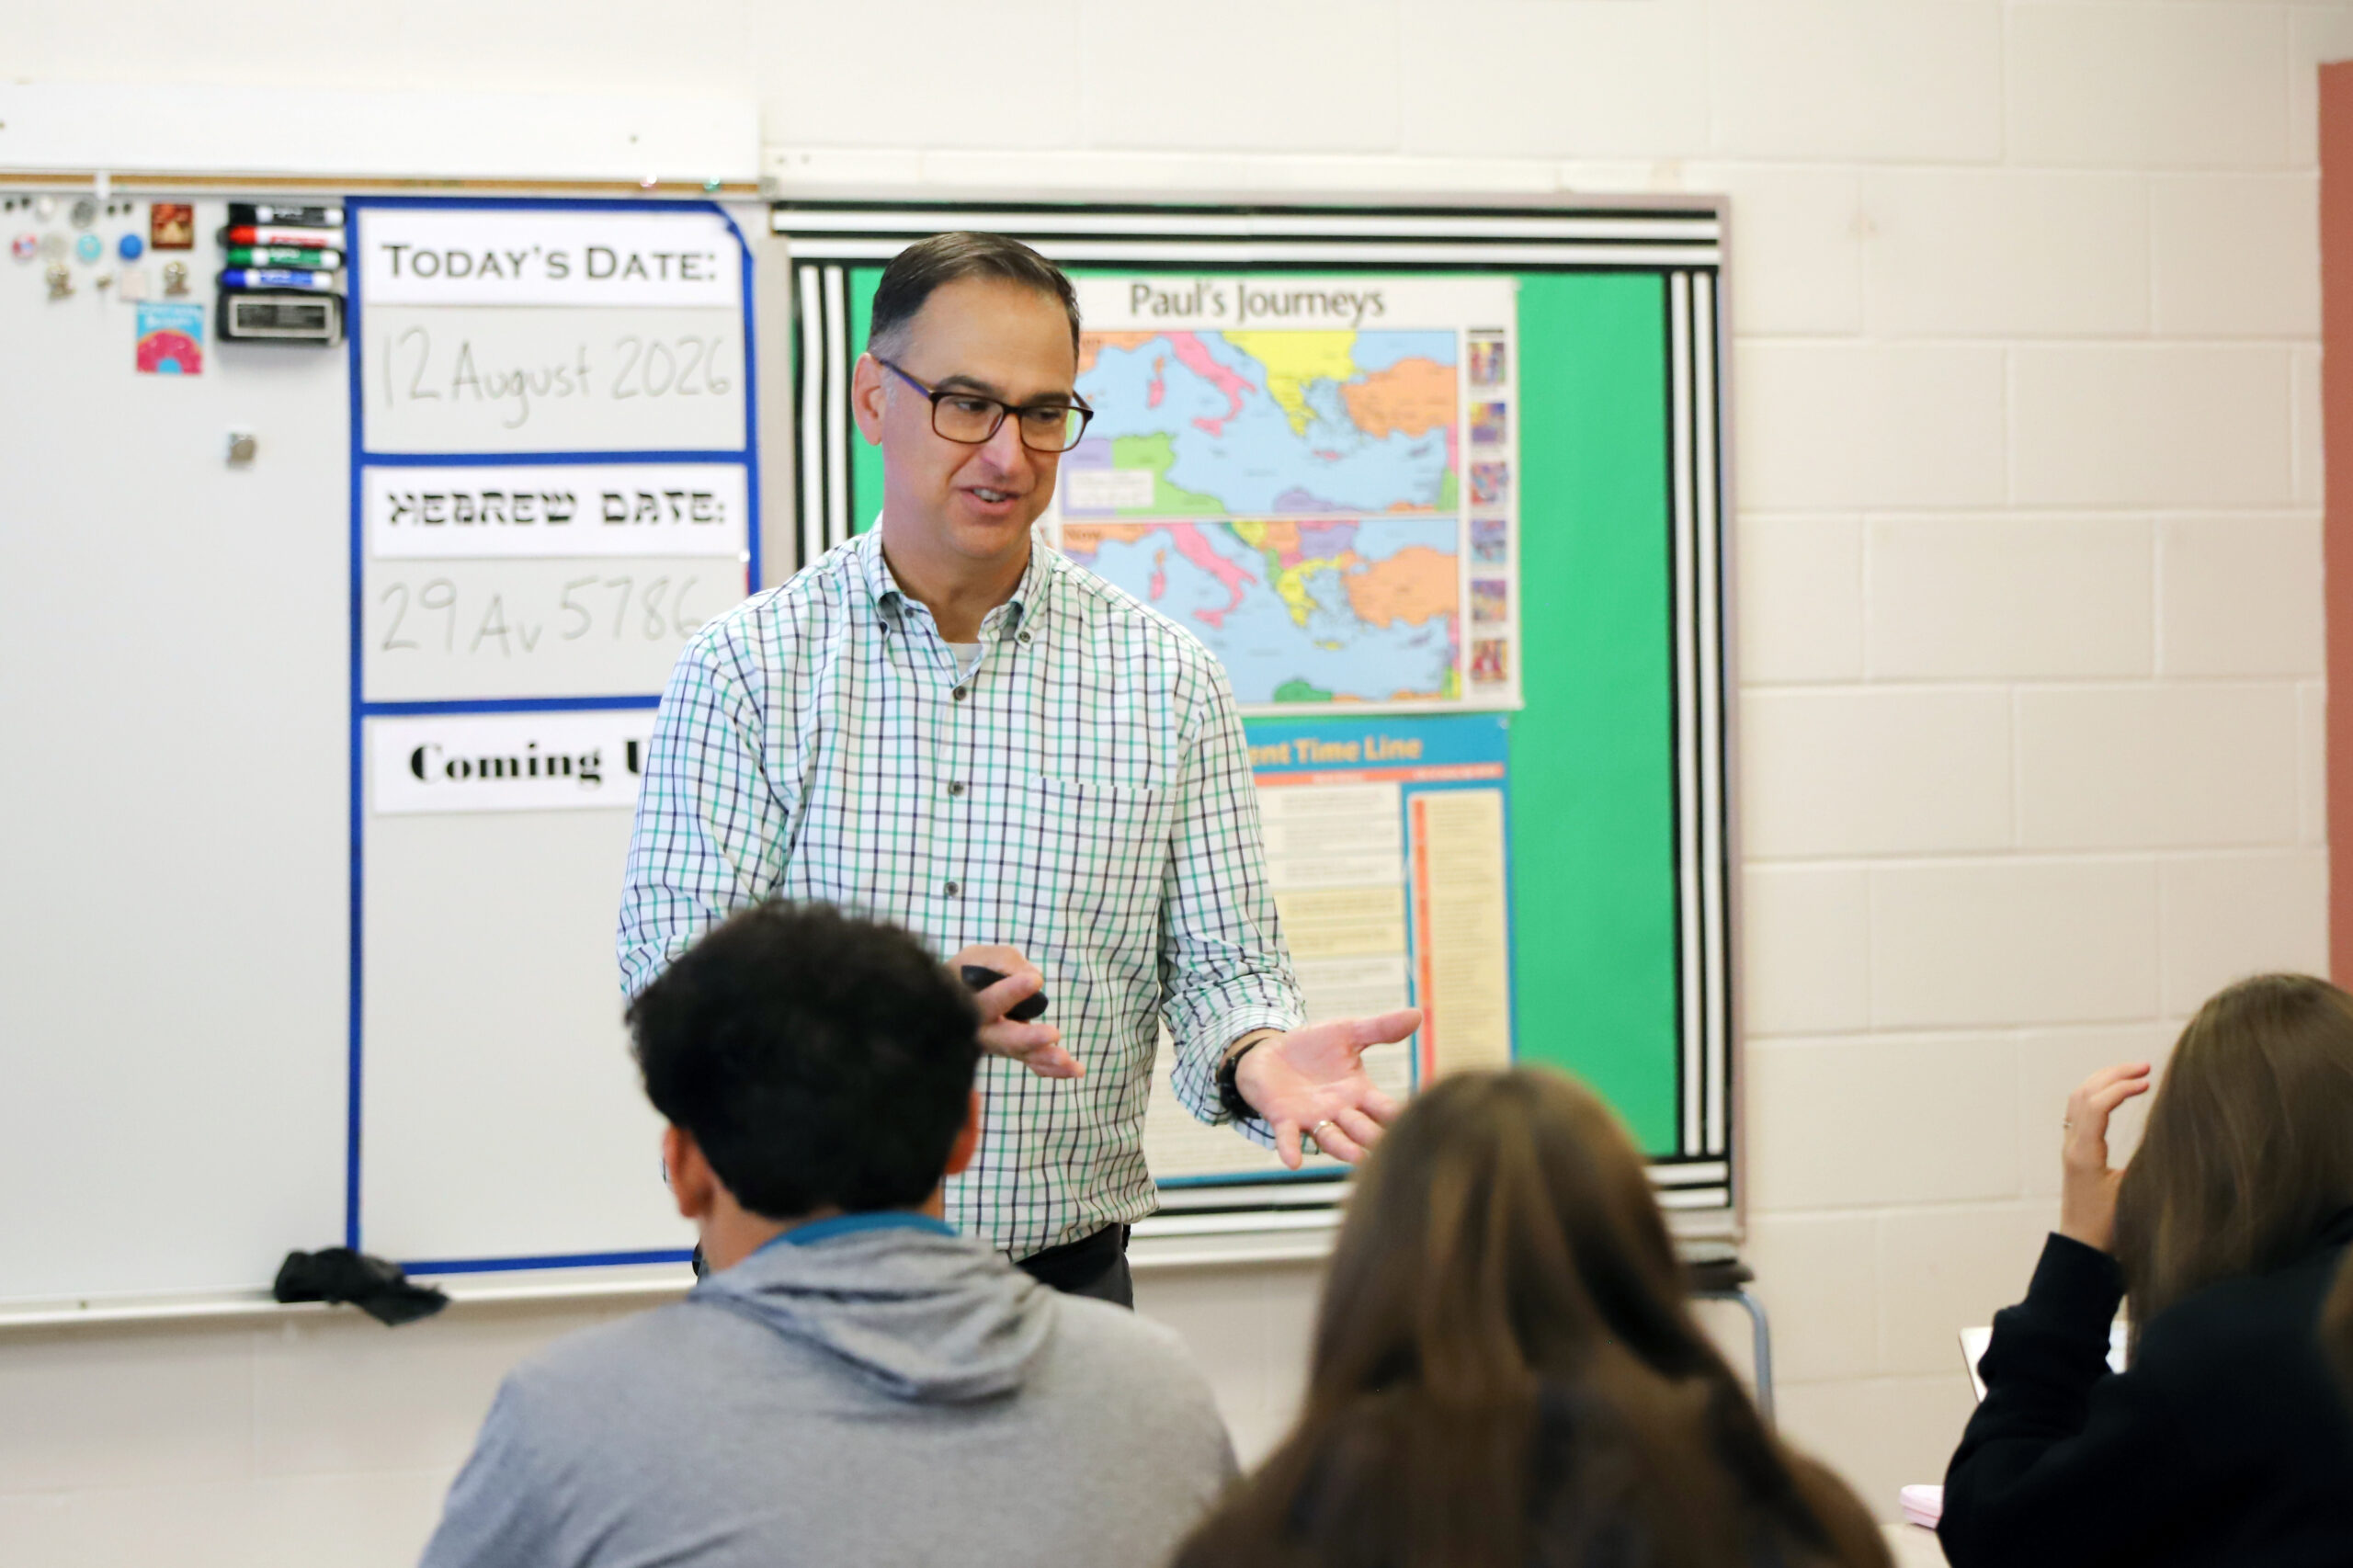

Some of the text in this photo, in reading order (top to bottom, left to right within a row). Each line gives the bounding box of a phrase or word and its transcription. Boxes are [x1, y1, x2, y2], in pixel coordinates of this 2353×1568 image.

[585, 246, 718, 281] DATE:
[1130, 282, 1385, 328] Paul's Journeys
[381, 324, 733, 430] 12 August 2026
[388, 490, 725, 527] HEBREW DATE:
[379, 575, 703, 657] 29 Av 5786
[408, 741, 604, 790] Coming
[1292, 737, 1361, 764] Time
[1363, 735, 1424, 761] Line
